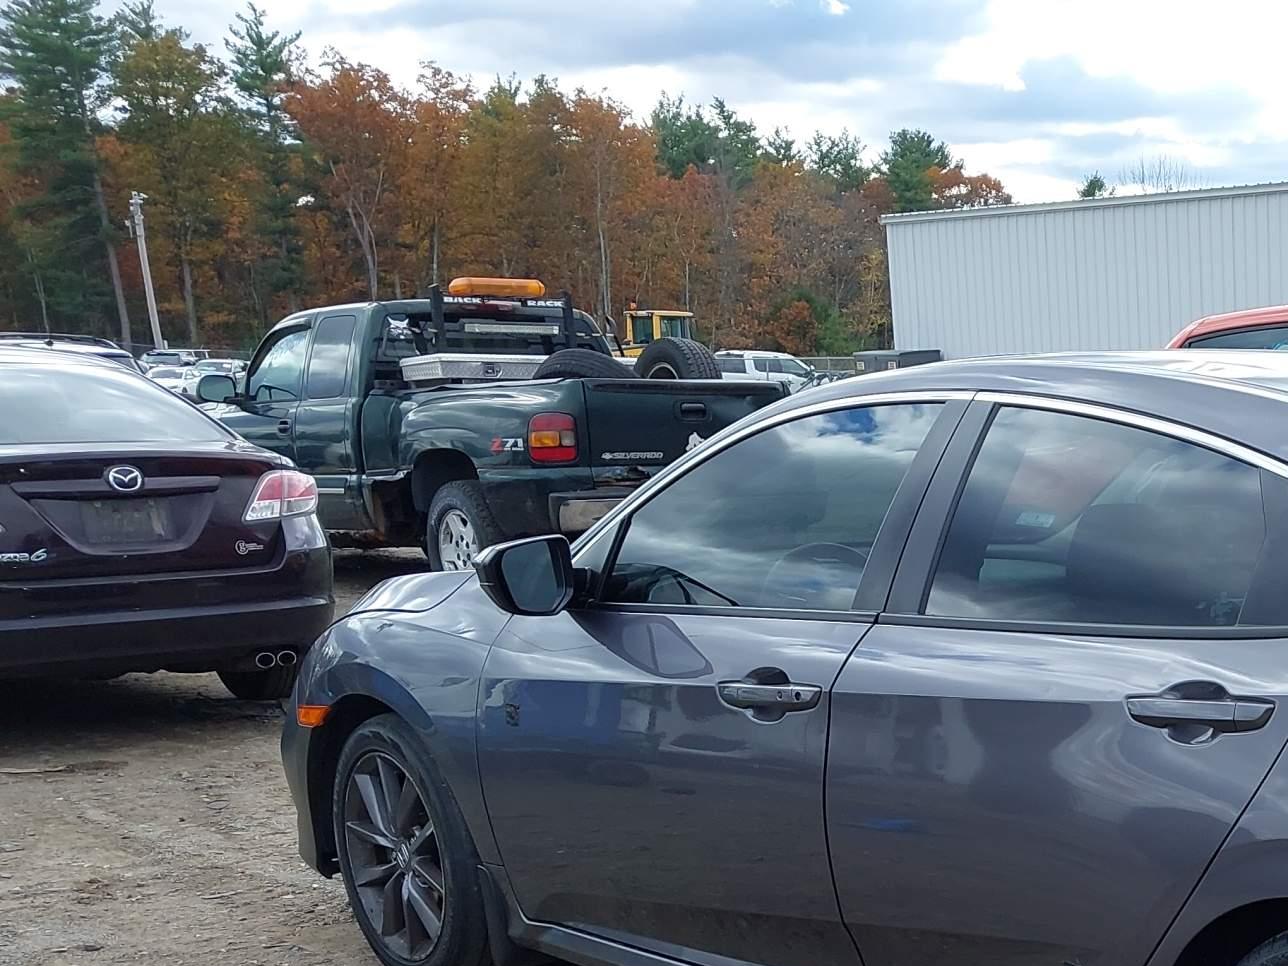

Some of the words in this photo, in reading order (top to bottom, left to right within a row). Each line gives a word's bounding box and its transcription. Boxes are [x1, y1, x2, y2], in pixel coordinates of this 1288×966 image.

[443, 296, 482, 304] BACK
[527, 299, 564, 307] RACK
[489, 438, 525, 451] Z71
[0, 548, 47, 561] zda6
